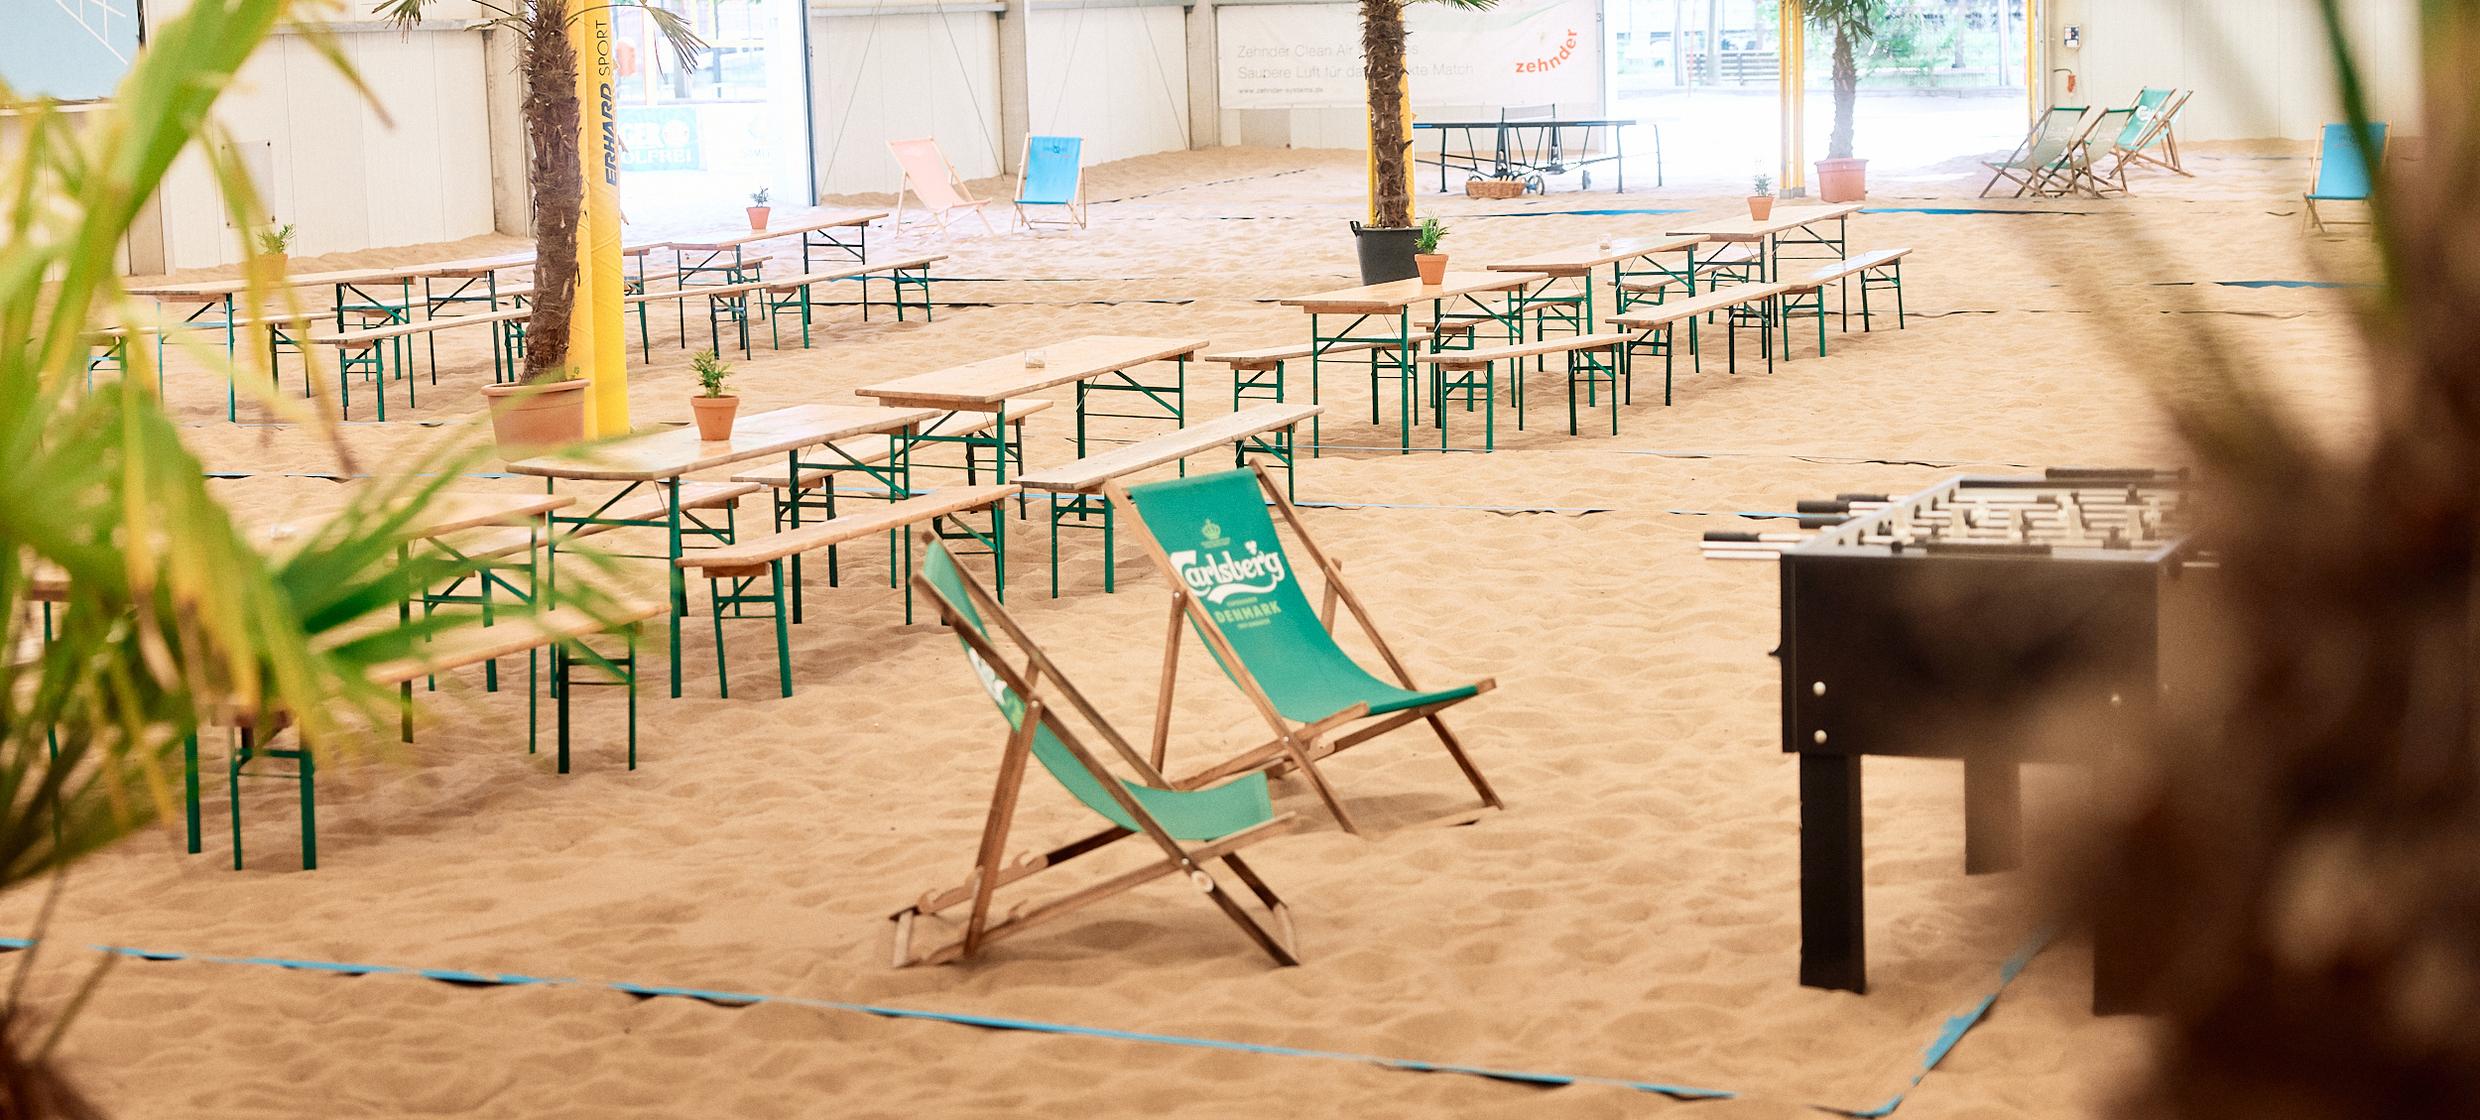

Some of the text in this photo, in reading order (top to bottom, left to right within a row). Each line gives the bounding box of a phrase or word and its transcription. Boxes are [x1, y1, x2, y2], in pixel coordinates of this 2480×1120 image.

[1237, 45, 1290, 58] Zehnder
[1295, 44, 1332, 57] Clean
[1336, 44, 1353, 57] Air
[1515, 28, 1577, 73] zehnder
[1237, 66, 1292, 80] Saubere
[1296, 66, 1320, 79] Luft
[1346, 65, 1365, 79] da
[1432, 63, 1474, 77] Match
[595, 20, 617, 187] ERHARD SPORT
[1170, 541, 1285, 604] Carlsberg
[1214, 601, 1281, 624] DENMARK
